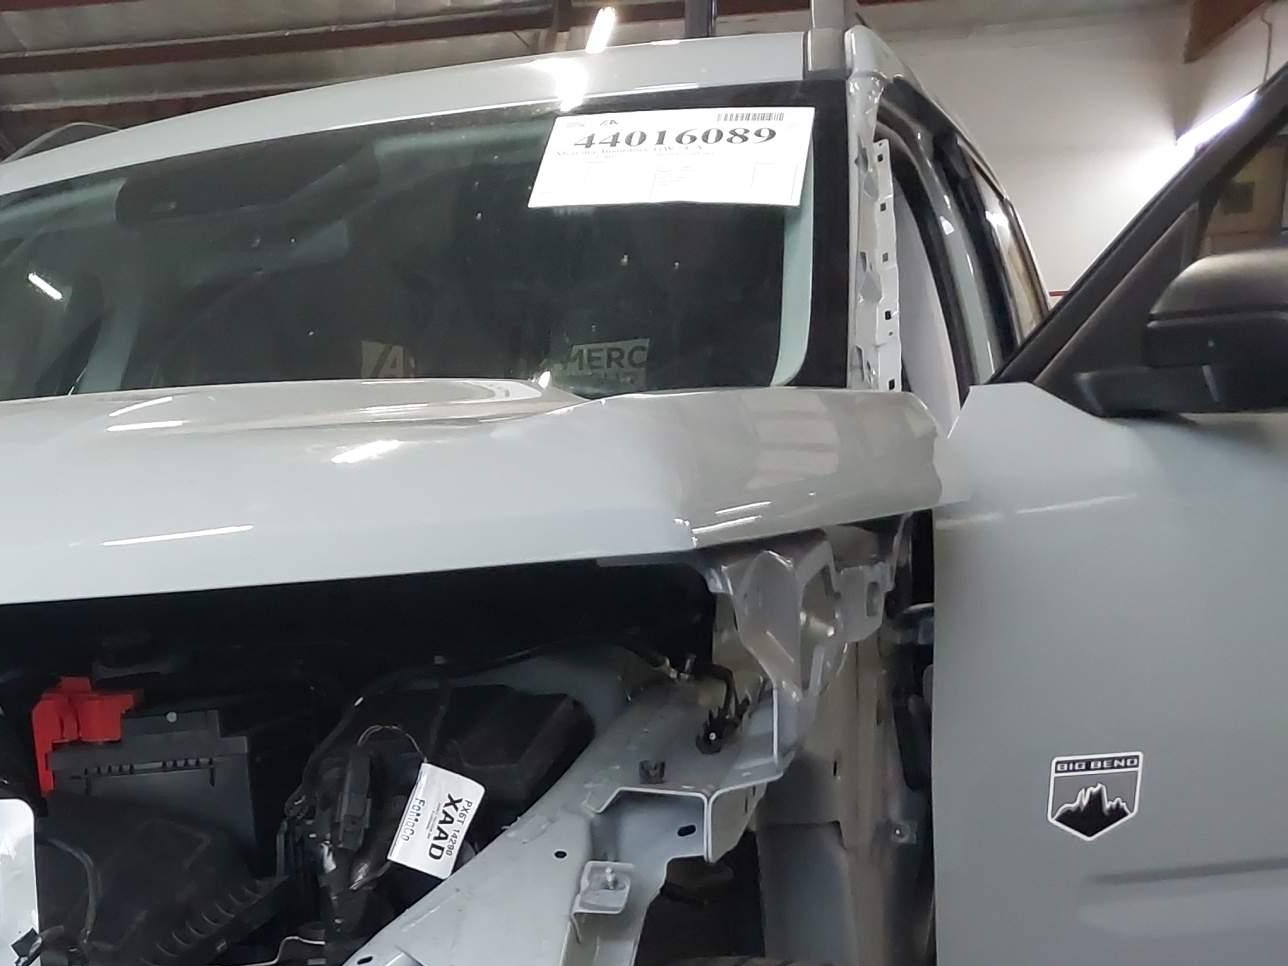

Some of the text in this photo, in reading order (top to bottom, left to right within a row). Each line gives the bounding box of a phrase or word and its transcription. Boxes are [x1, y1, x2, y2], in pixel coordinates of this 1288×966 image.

[573, 127, 777, 149] 44016089
[1056, 758, 1138, 772] BIG BEND
[428, 793, 464, 860] XAAD
